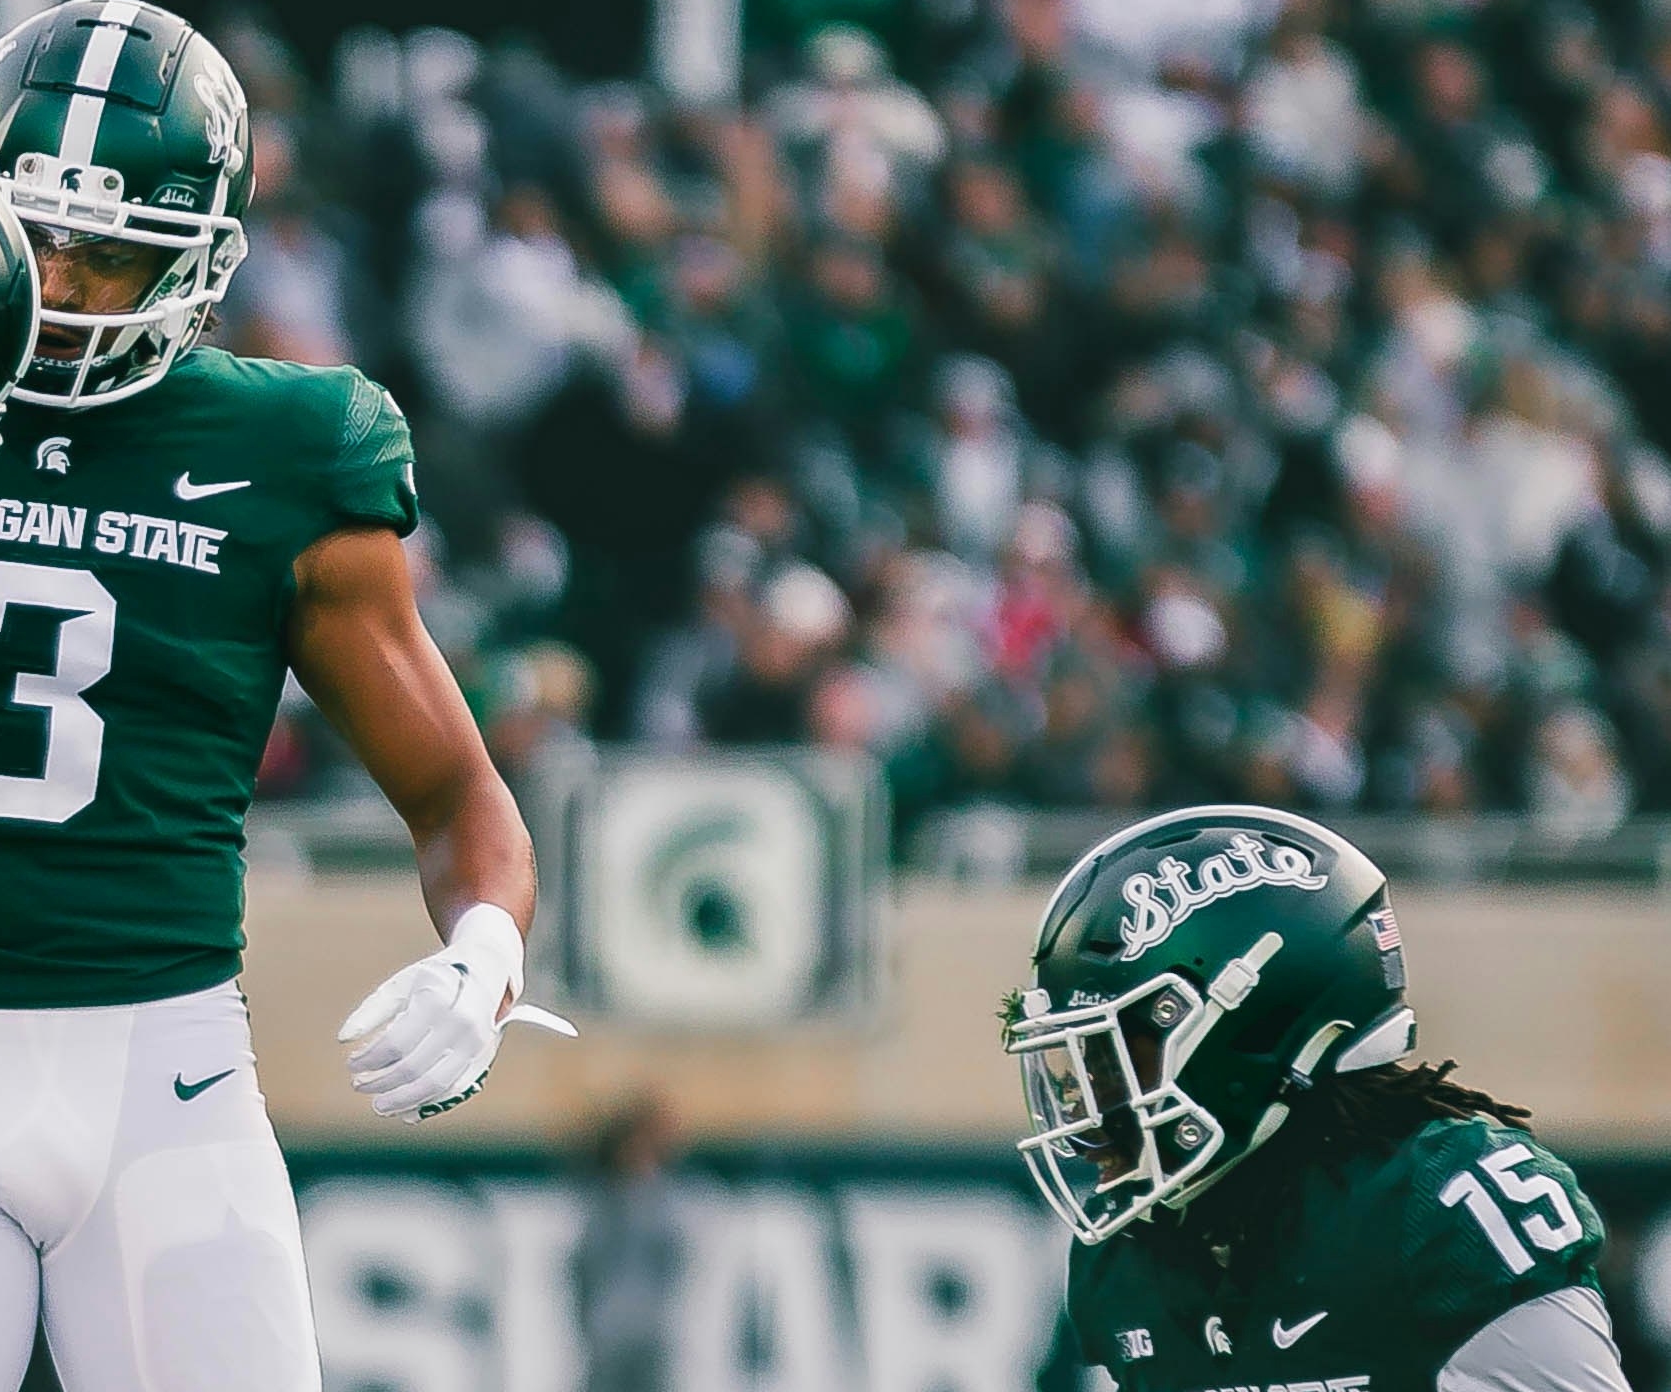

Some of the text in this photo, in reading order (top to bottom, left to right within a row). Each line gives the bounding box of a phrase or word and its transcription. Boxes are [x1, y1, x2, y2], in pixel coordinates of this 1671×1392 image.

[158, 187, 195, 208] State
[93, 510, 229, 575] STATE
[1119, 833, 1329, 962] State
[1438, 1142, 1584, 1276] 15
